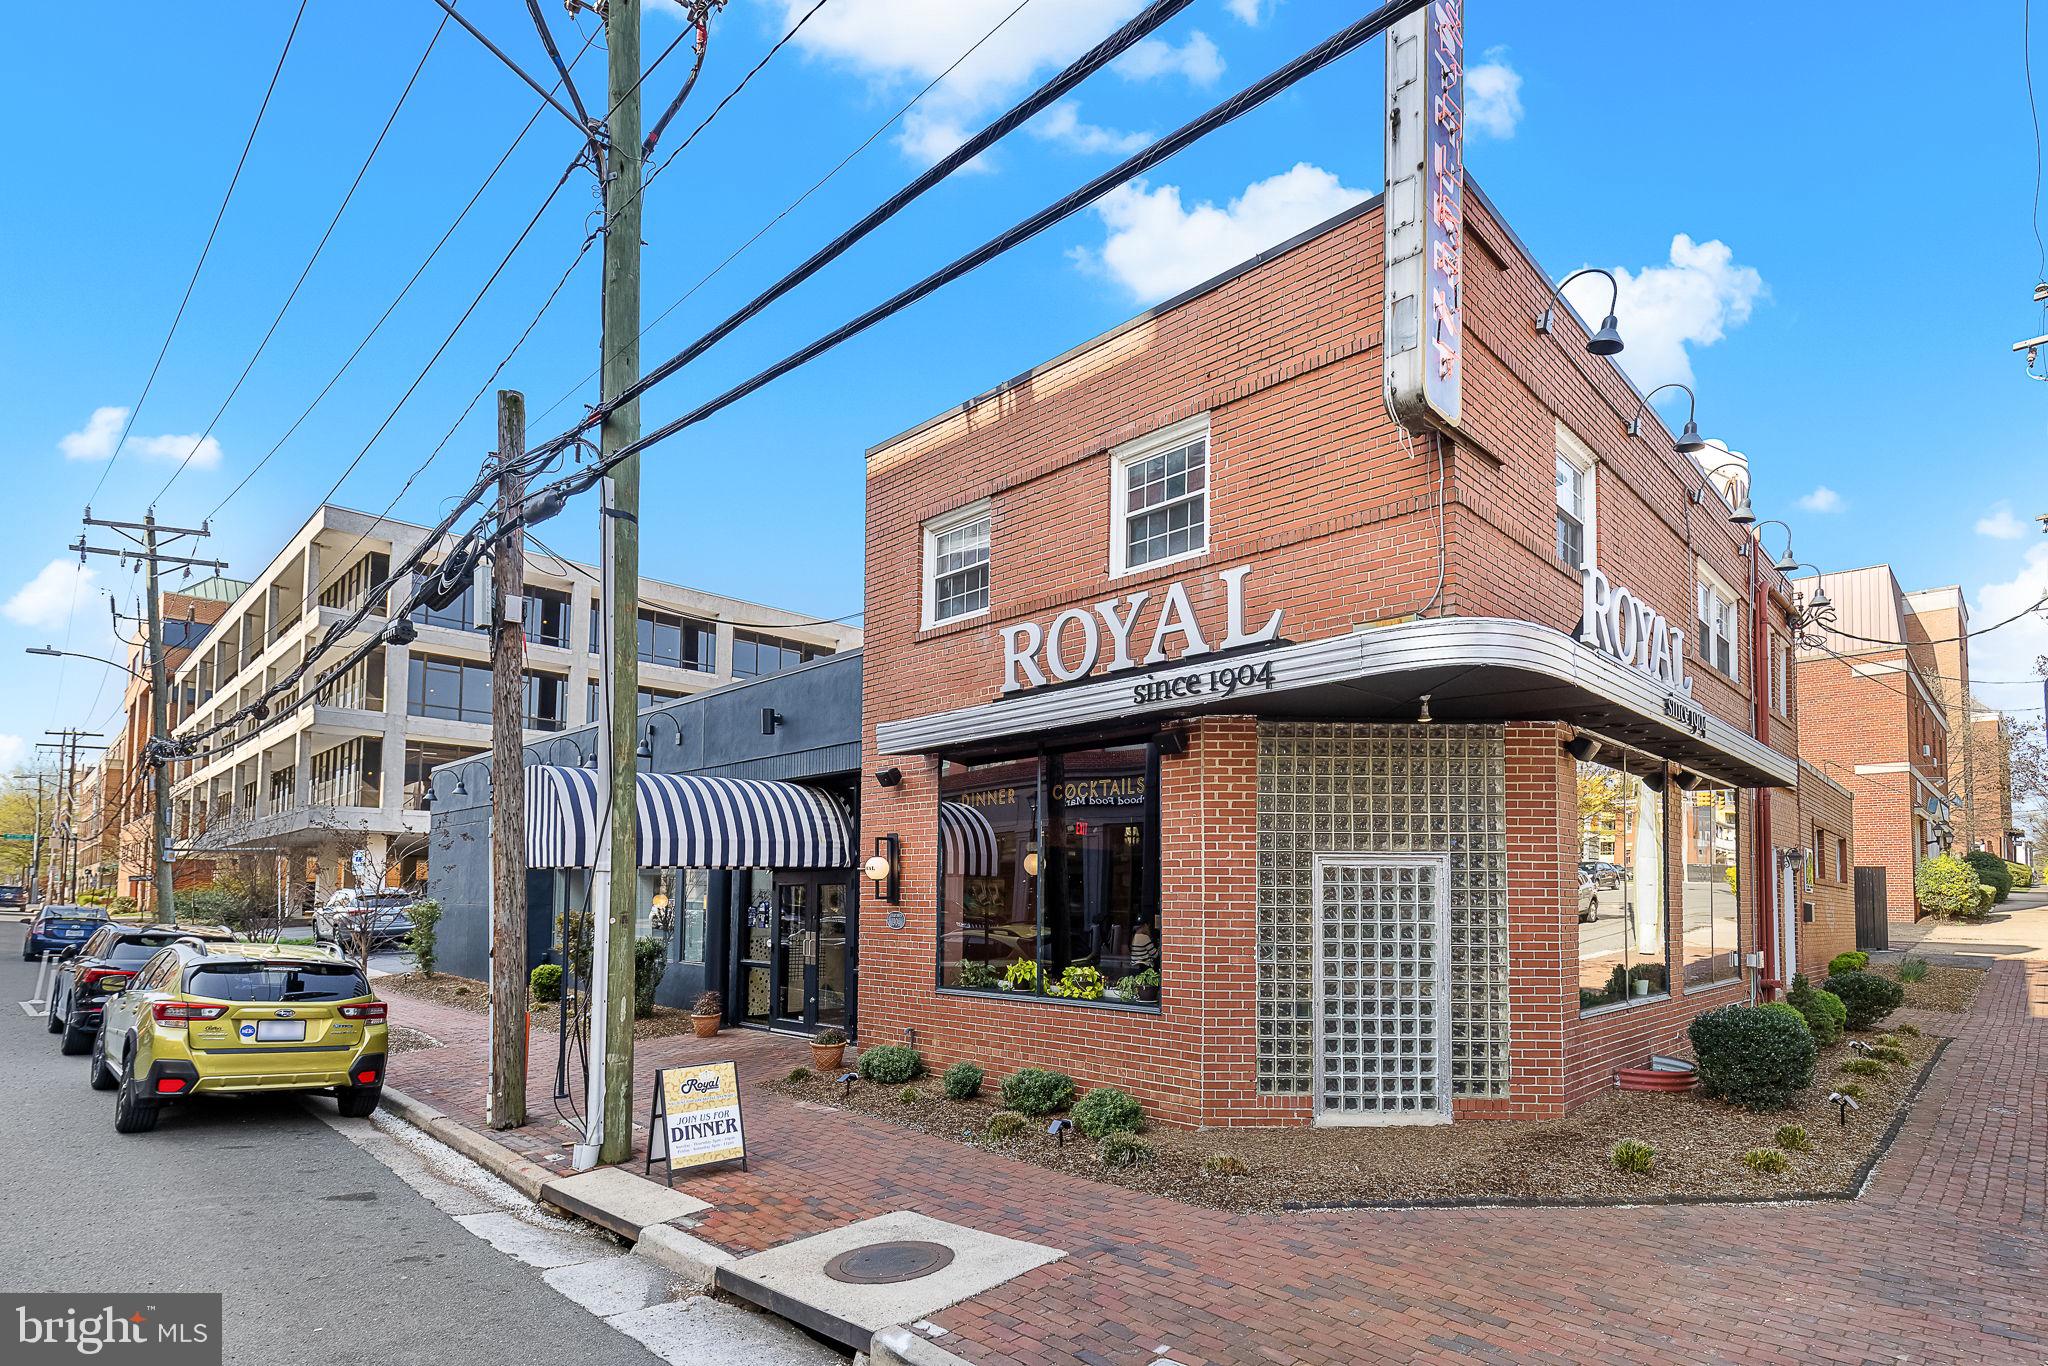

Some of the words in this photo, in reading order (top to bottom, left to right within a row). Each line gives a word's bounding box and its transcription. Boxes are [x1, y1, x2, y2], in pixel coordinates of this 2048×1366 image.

[1000, 564, 1285, 693] ROYAL
[1580, 563, 1693, 698] ROYAL
[1134, 673, 1201, 704] since
[1209, 660, 1276, 699] 1904
[1664, 692, 1690, 725] since
[961, 788, 1016, 807] DINNER
[1052, 776, 1145, 800] COCKTAILS
[681, 1076, 720, 1093] Royal
[671, 1118, 738, 1143] DINNER
[677, 1115, 698, 1126] JOIN
[700, 1113, 711, 1121] US
[713, 1110, 730, 1120] FOR
